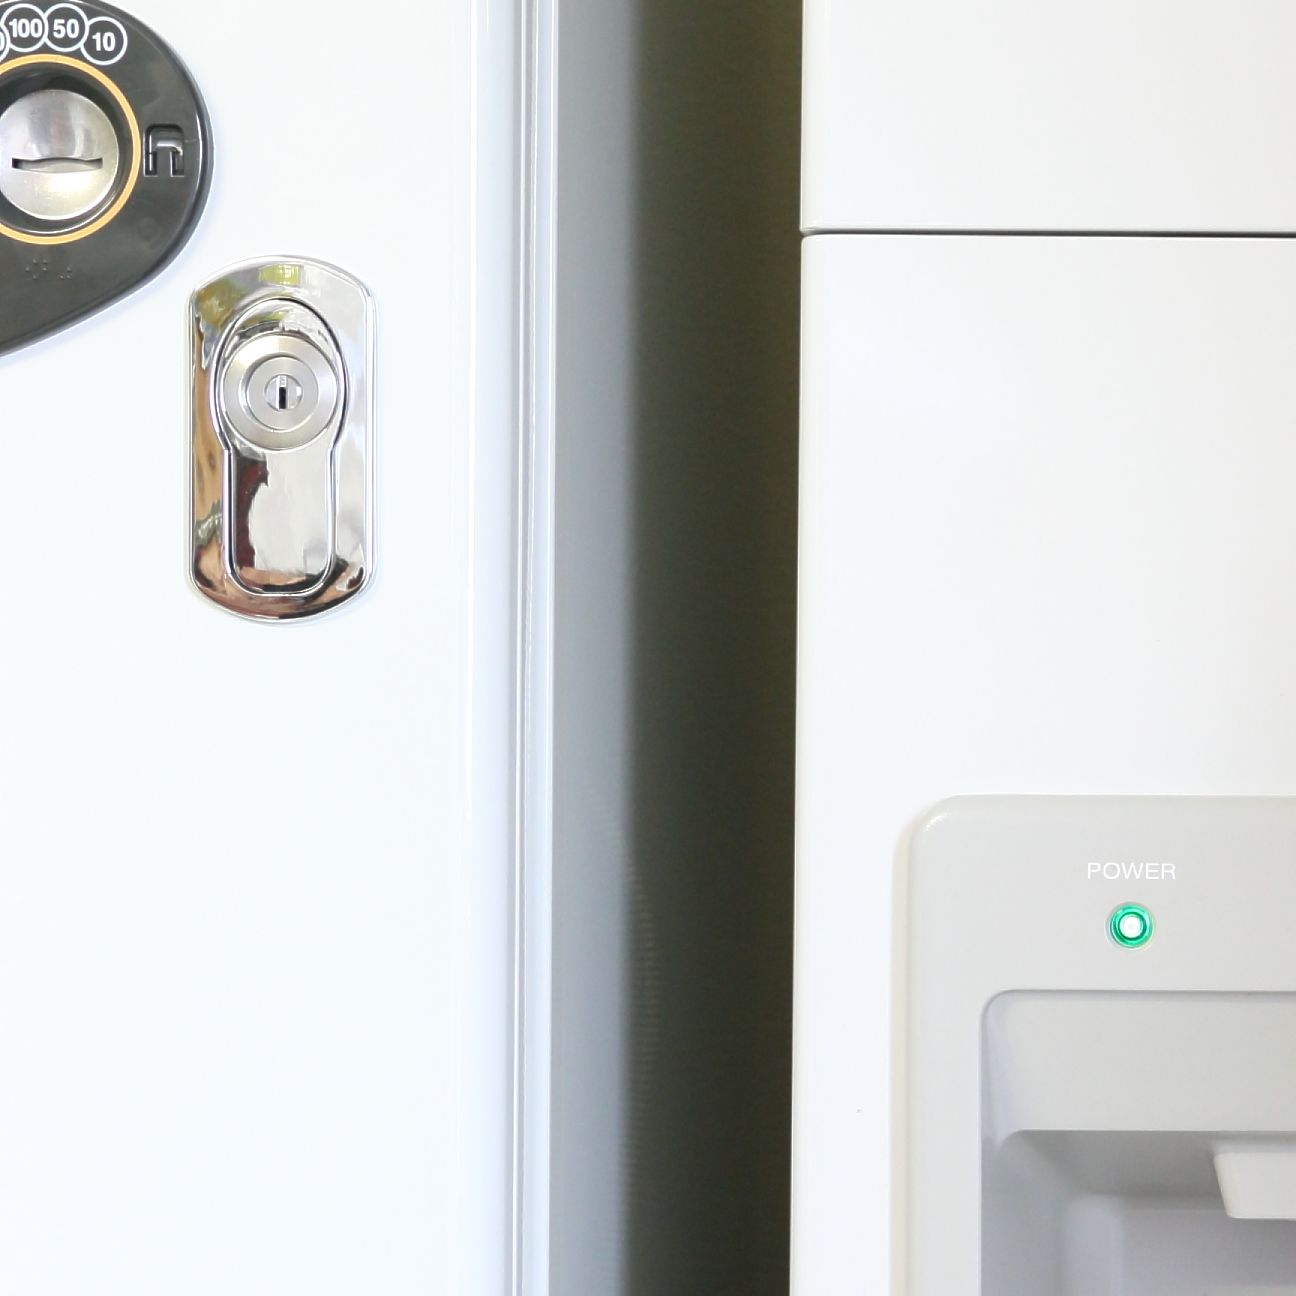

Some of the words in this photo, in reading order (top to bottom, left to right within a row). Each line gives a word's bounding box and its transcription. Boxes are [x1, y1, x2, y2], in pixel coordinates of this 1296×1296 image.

[9, 18, 43, 39] 100
[53, 18, 80, 39] 50
[92, 31, 116, 52] 10
[1087, 862, 1176, 881] POWER
